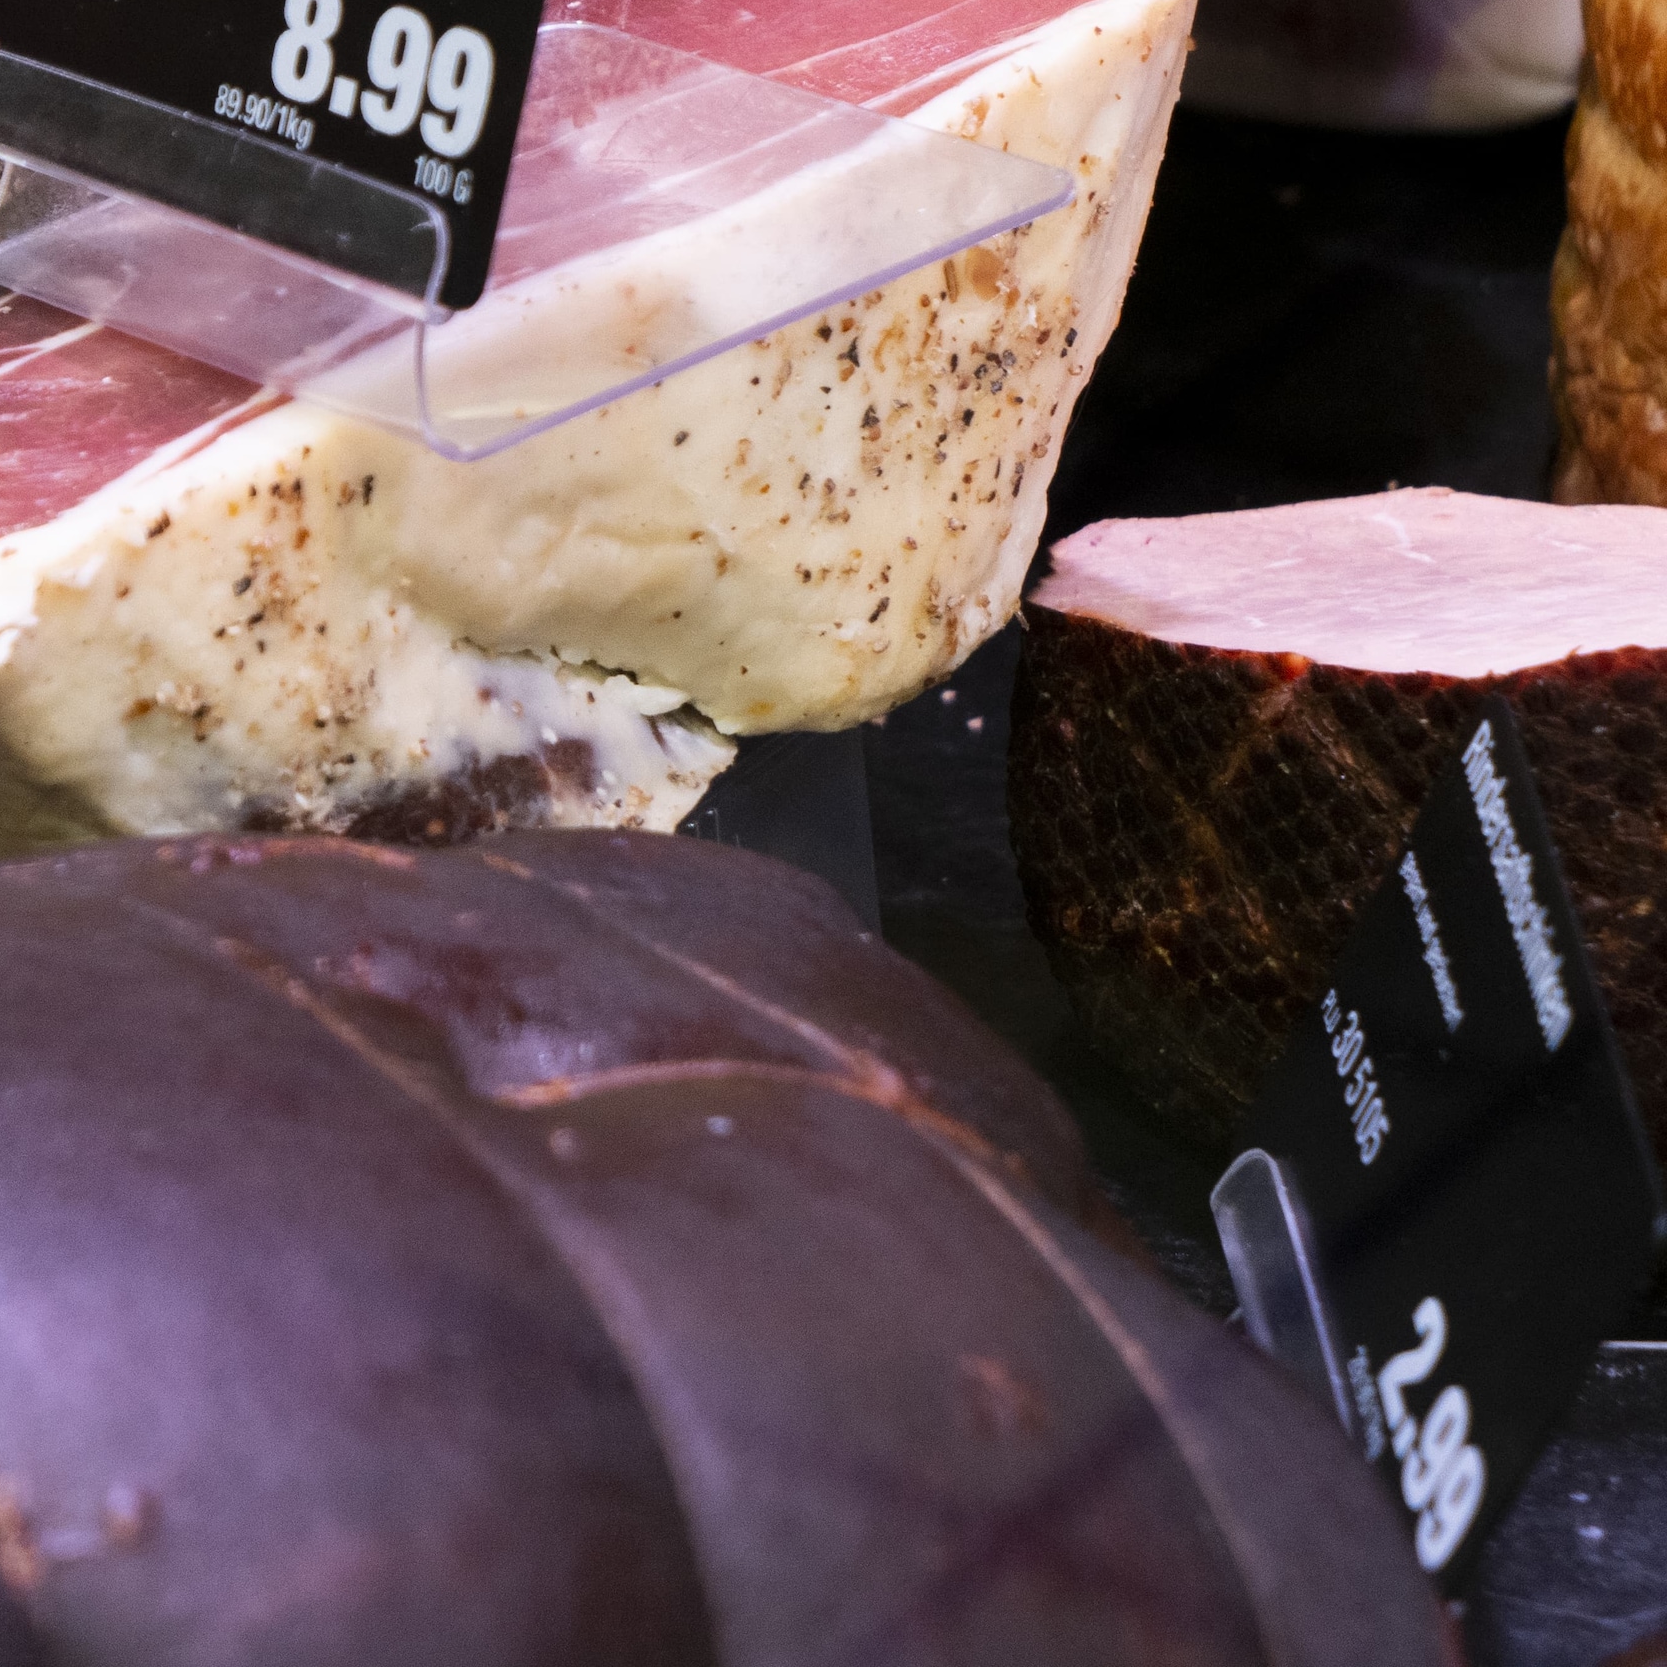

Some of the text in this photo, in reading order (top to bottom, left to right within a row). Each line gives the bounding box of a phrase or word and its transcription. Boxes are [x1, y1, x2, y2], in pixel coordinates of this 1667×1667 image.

[213, 83, 313, 150] 89.90/1kg
[412, 154, 473, 204] 100 G
[1321, 988, 1343, 1032] PLU
[1330, 1011, 1366, 1078] 30
[1376, 1296, 1485, 1573] 2.99
